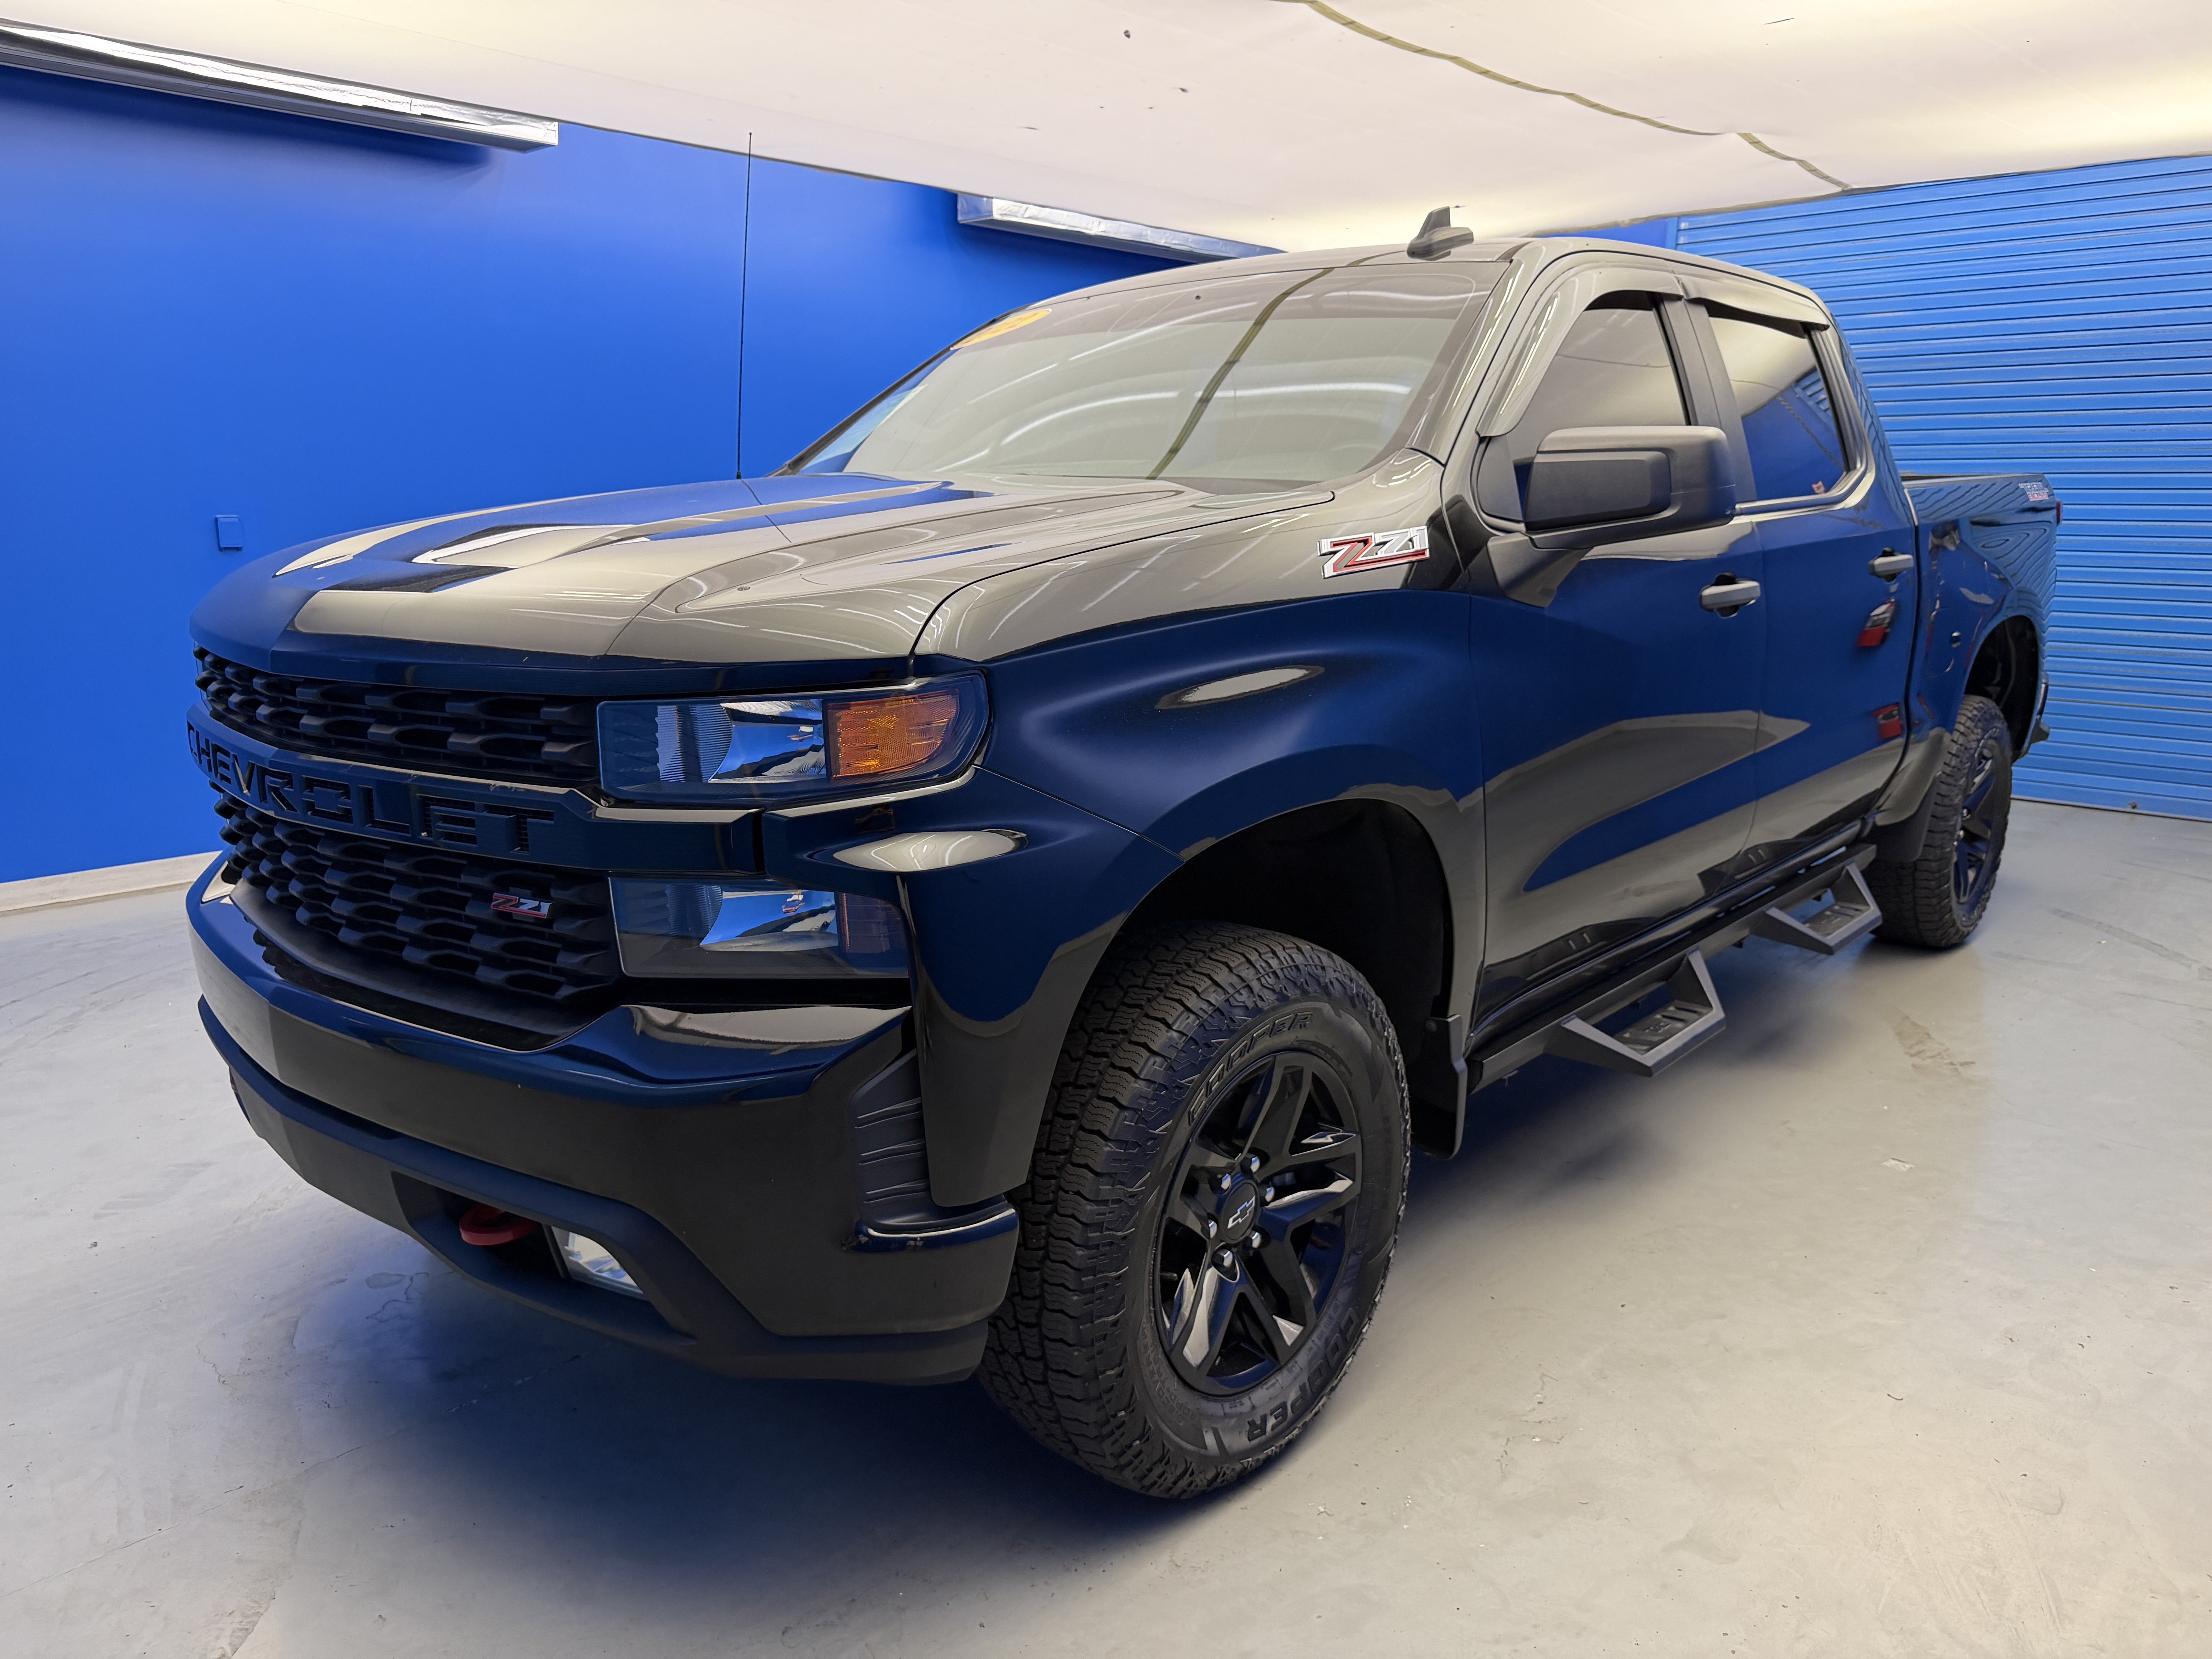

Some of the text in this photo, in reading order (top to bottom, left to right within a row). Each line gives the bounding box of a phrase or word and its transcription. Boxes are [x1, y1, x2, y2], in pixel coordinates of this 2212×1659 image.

[1317, 526, 1429, 579] Z71
[187, 720, 555, 854] CHEVROLET
[491, 893, 552, 919] Z71
[1189, 1012, 1313, 1125] COOPER
[1247, 1307, 1355, 1441] COOPER
